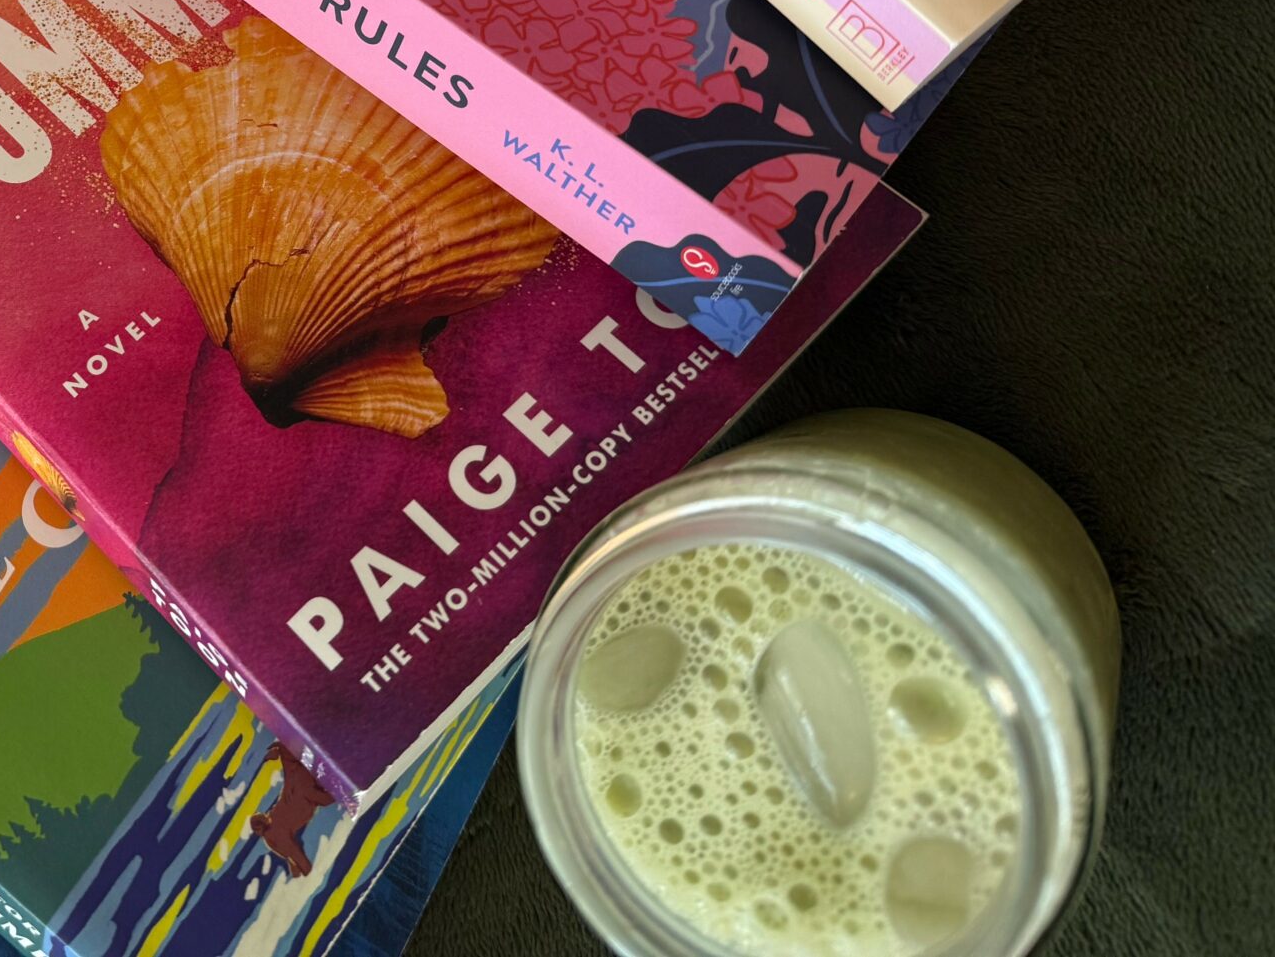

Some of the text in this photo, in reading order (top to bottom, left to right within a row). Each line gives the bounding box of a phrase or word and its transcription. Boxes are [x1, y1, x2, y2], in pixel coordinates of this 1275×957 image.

[876, 45, 910, 82] BERKLEY
[502, 129, 638, 235] WALTHER
[62, 309, 161, 399] NOVEL
[77, 307, 100, 331] A
[286, 391, 574, 672] PAIGE
[360, 643, 413, 693] THE
[409, 423, 633, 645] TWO-MILLION-COPY
